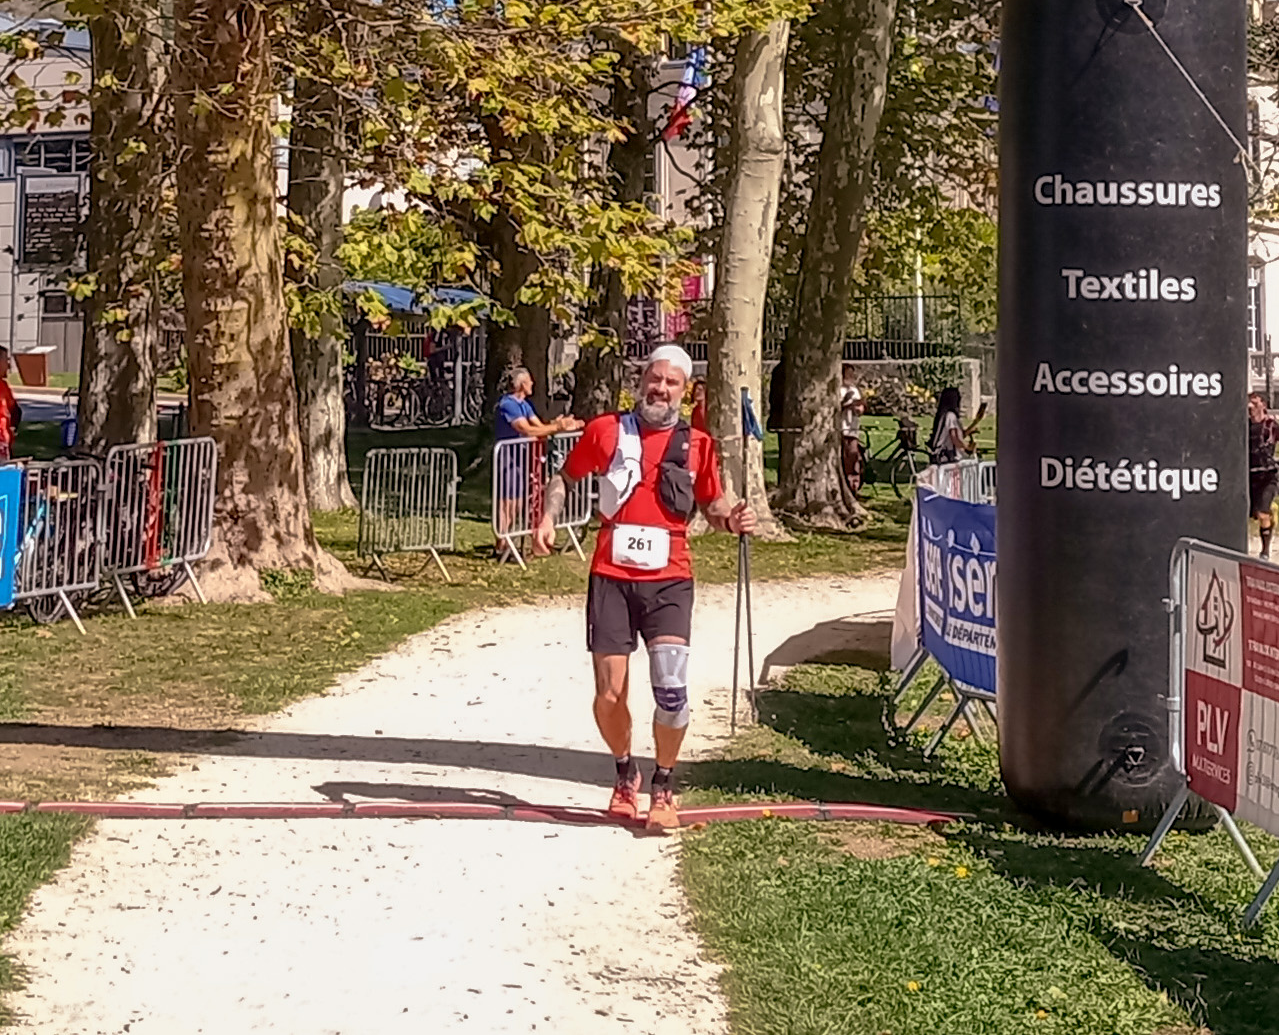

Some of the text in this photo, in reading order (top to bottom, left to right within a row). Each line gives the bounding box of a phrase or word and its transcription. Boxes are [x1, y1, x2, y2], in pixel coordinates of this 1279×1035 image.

[1033, 173, 1222, 208] Chaussures
[1061, 268, 1197, 301] Textiles
[1033, 363, 1222, 396] Accessoires
[1040, 456, 1219, 501] Diététique
[627, 536, 653, 552] 261
[946, 528, 997, 619] isèr
[1196, 699, 1229, 756] PLV
